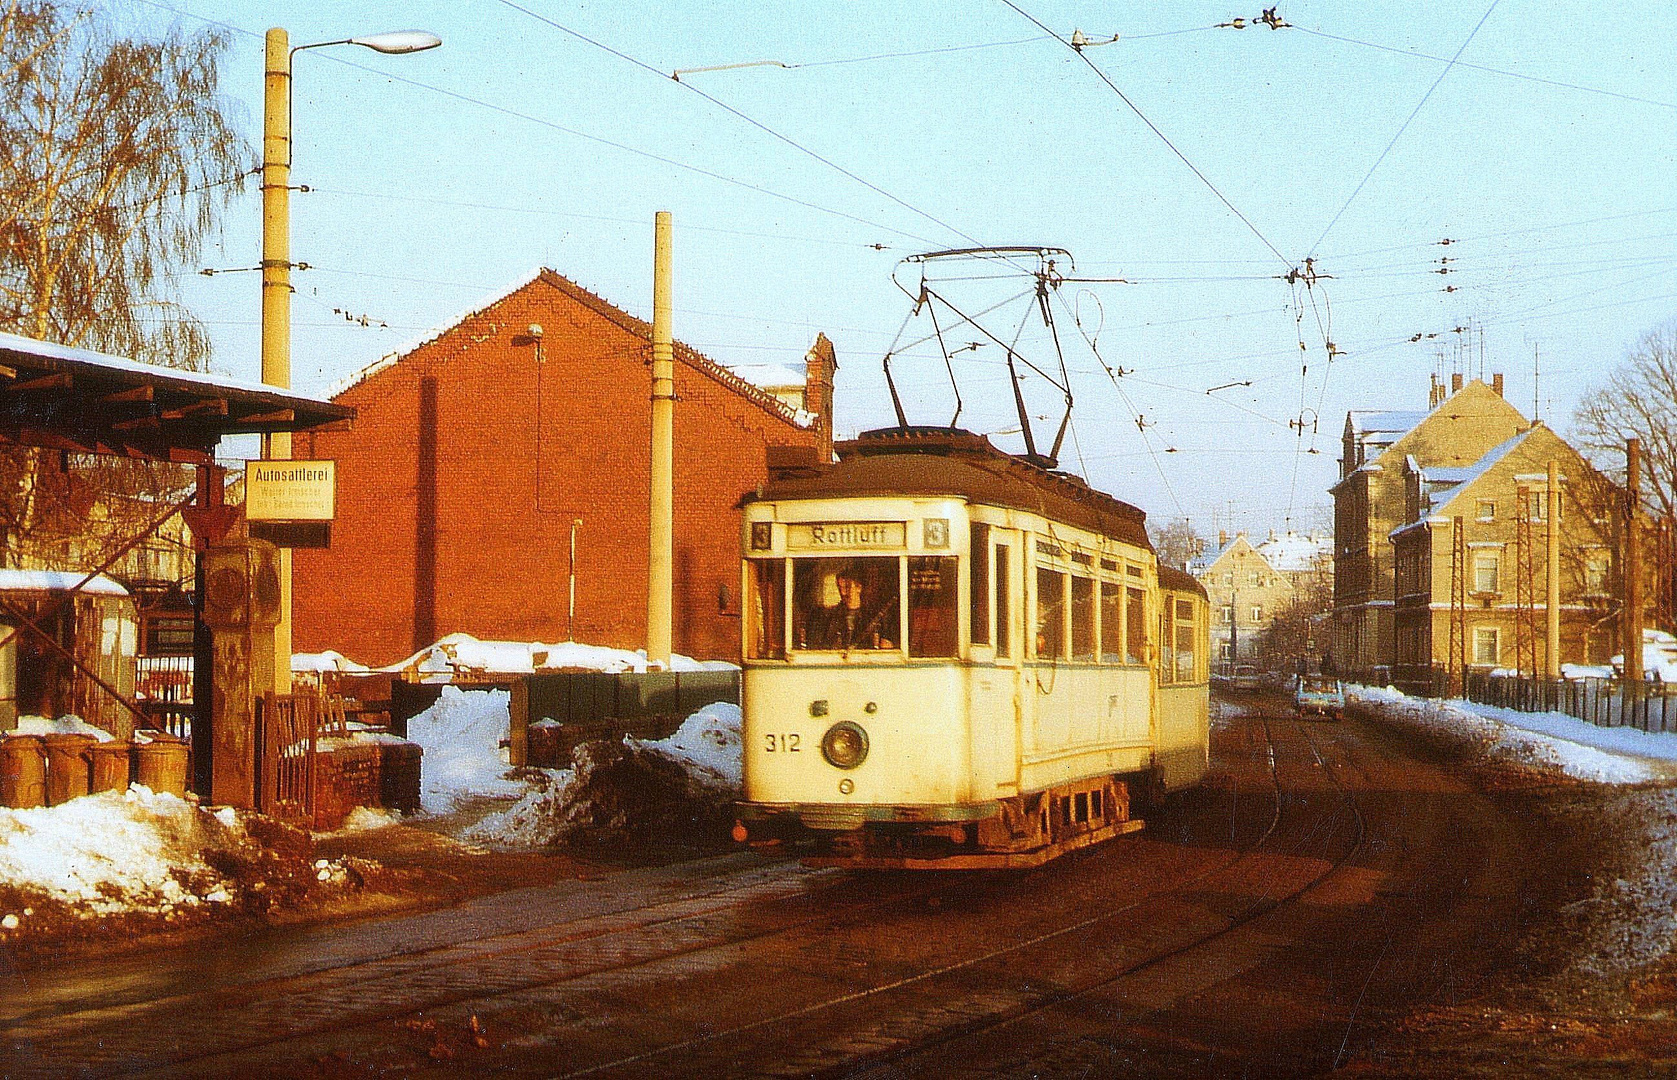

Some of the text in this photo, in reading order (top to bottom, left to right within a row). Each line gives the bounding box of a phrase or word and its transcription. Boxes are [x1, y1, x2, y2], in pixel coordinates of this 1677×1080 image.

[255, 467, 328, 482] Autosattlerei
[812, 524, 886, 543] Rottluff
[764, 733, 800, 752] 312
